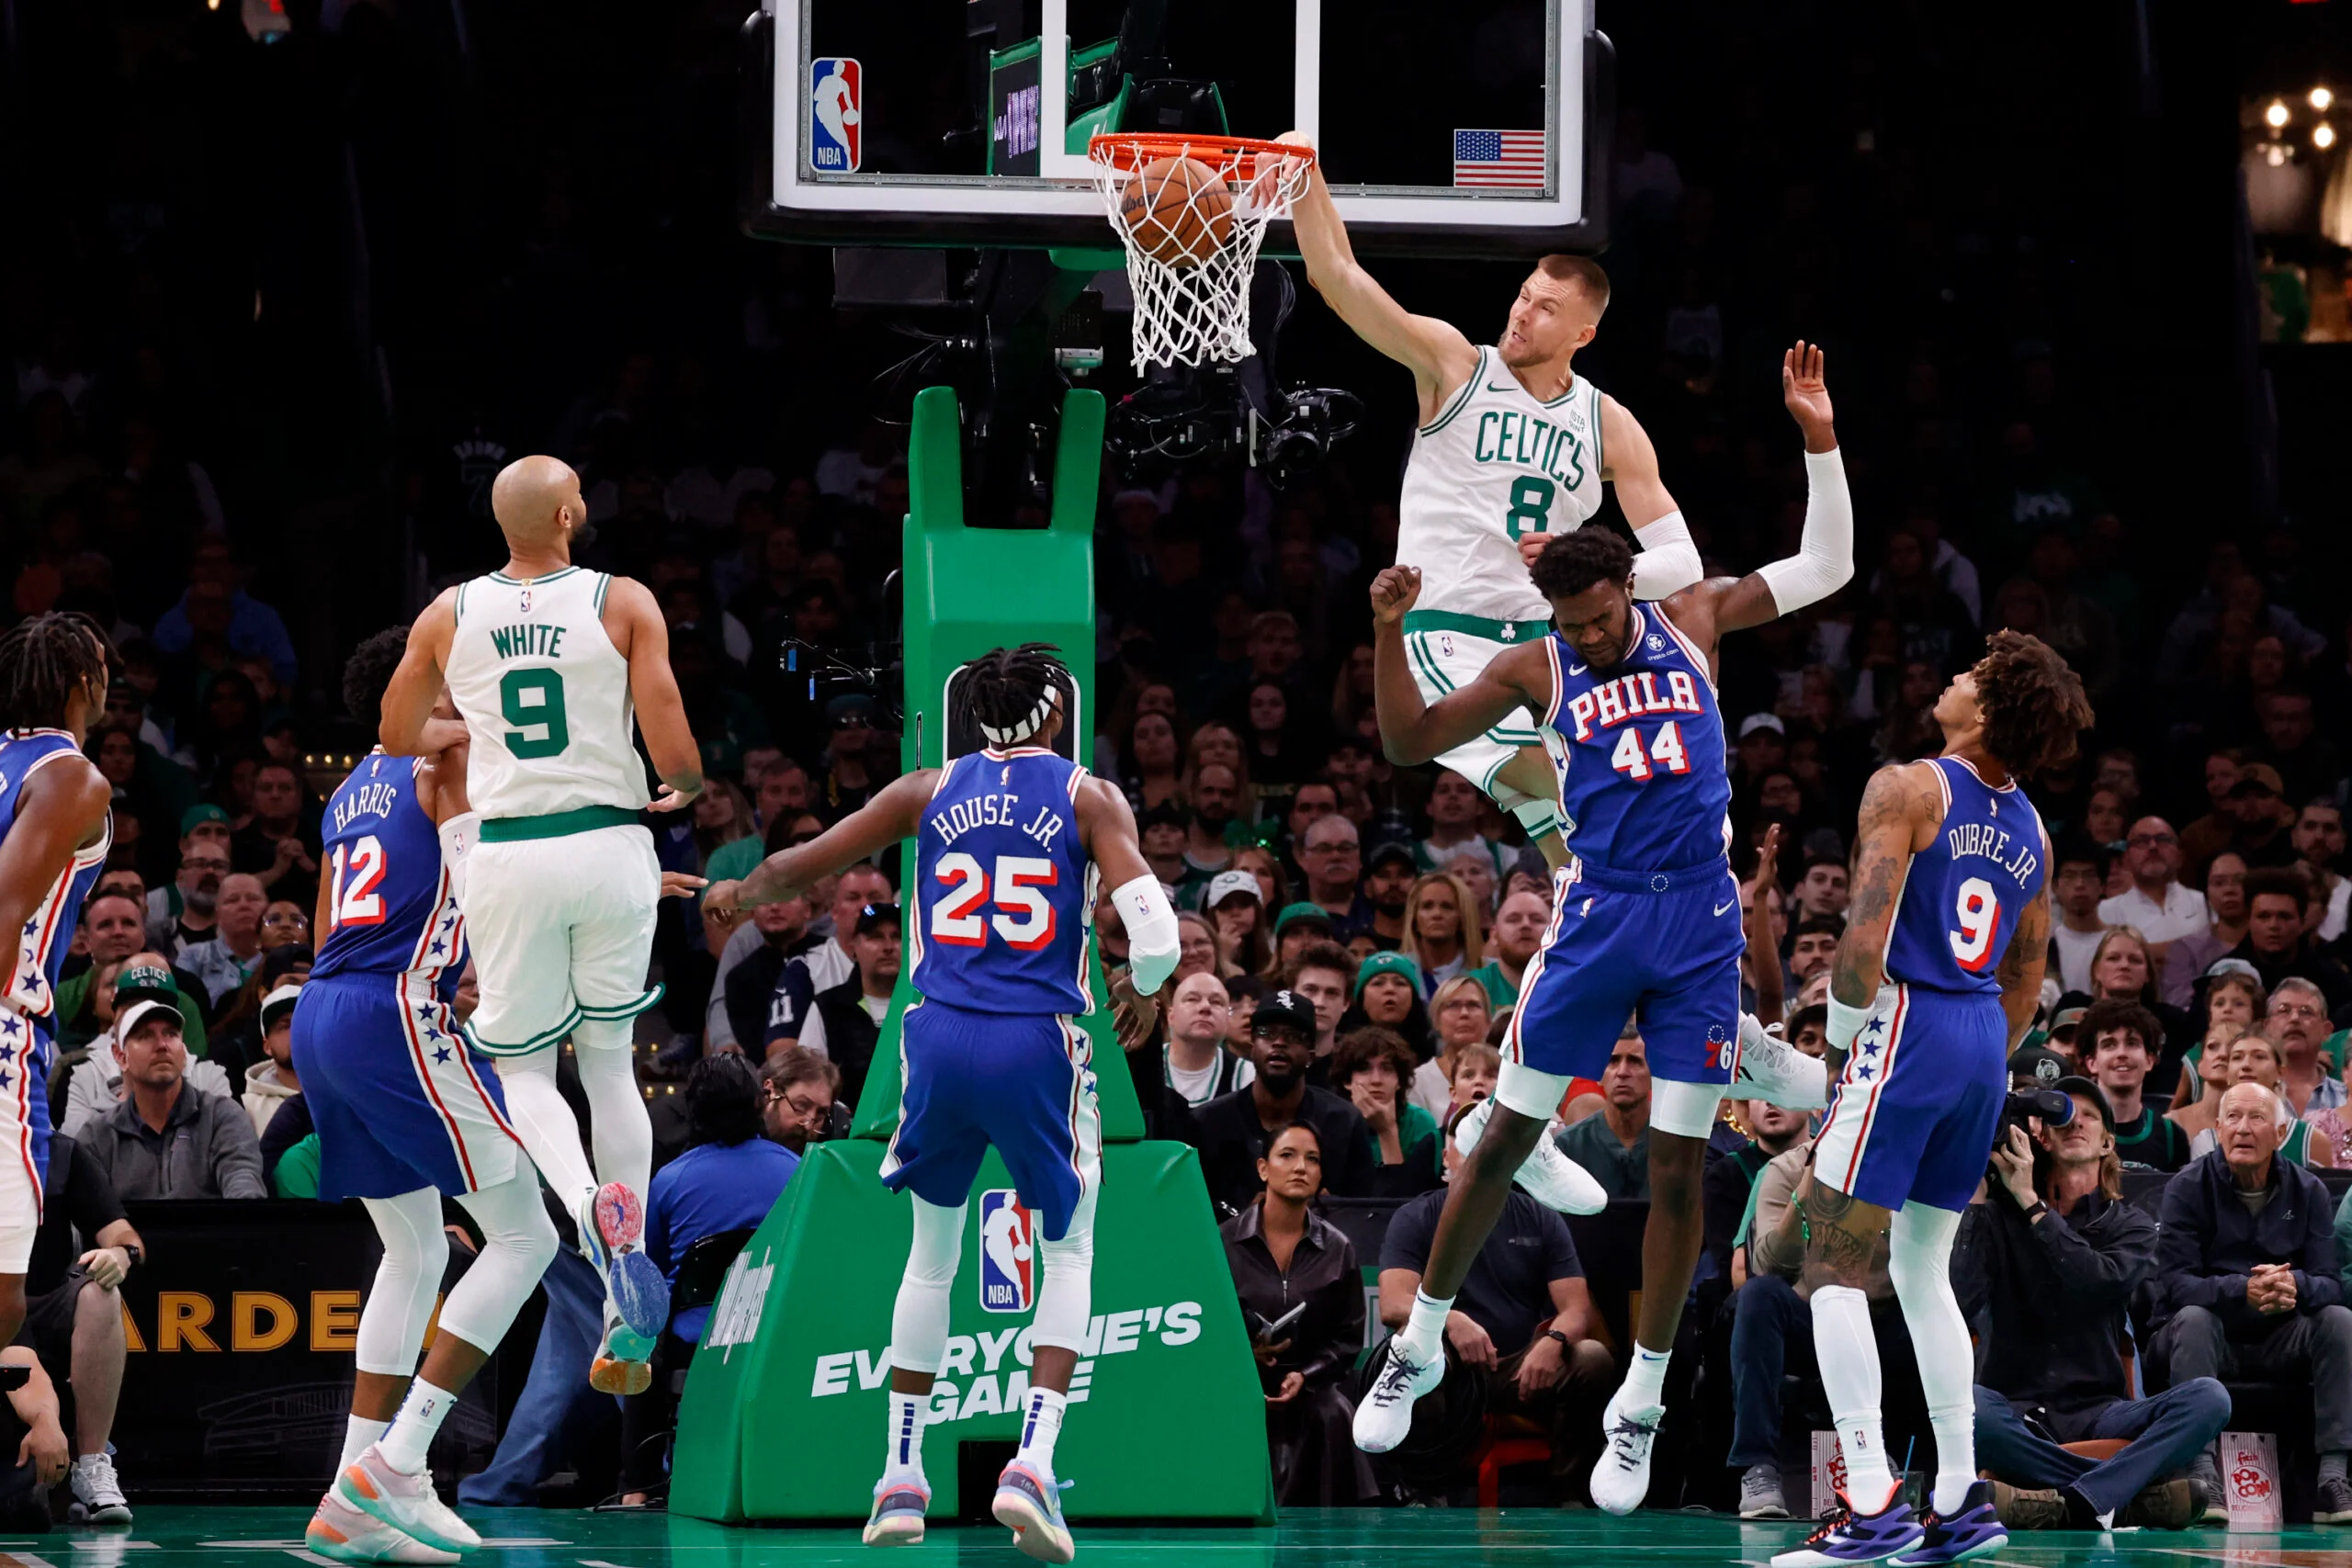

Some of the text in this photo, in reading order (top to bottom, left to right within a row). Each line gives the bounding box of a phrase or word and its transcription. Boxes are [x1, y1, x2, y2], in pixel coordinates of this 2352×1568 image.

[817, 147, 842, 165] NBA
[1475, 412, 1585, 492] CELTICS
[1507, 475, 1556, 544] 8
[490, 624, 567, 660] WHITE
[1647, 649, 1679, 661] crypto.com
[500, 668, 570, 760] 9
[1567, 671, 1704, 743] PHILA
[1611, 720, 1691, 782] 44
[334, 783, 397, 834] HARRIS
[931, 794, 1063, 852] HOUSE JR.
[1949, 823, 2037, 889] OUBRE JR.
[331, 835, 388, 933] 12
[931, 852, 1058, 952] 25
[1950, 876, 2002, 973] 9
[130, 965, 167, 983] CELTICS
[769, 995, 795, 1028] 11
[1704, 1040, 1733, 1070] 76
[988, 1285, 1013, 1305] NBA
[811, 1301, 1203, 1398] EVRYNE'S
[1827, 1456, 1846, 1477] PO
[1832, 1472, 1848, 1490] CO
[2233, 1469, 2260, 1486] POP
[2238, 1480, 2270, 1498] CORN
